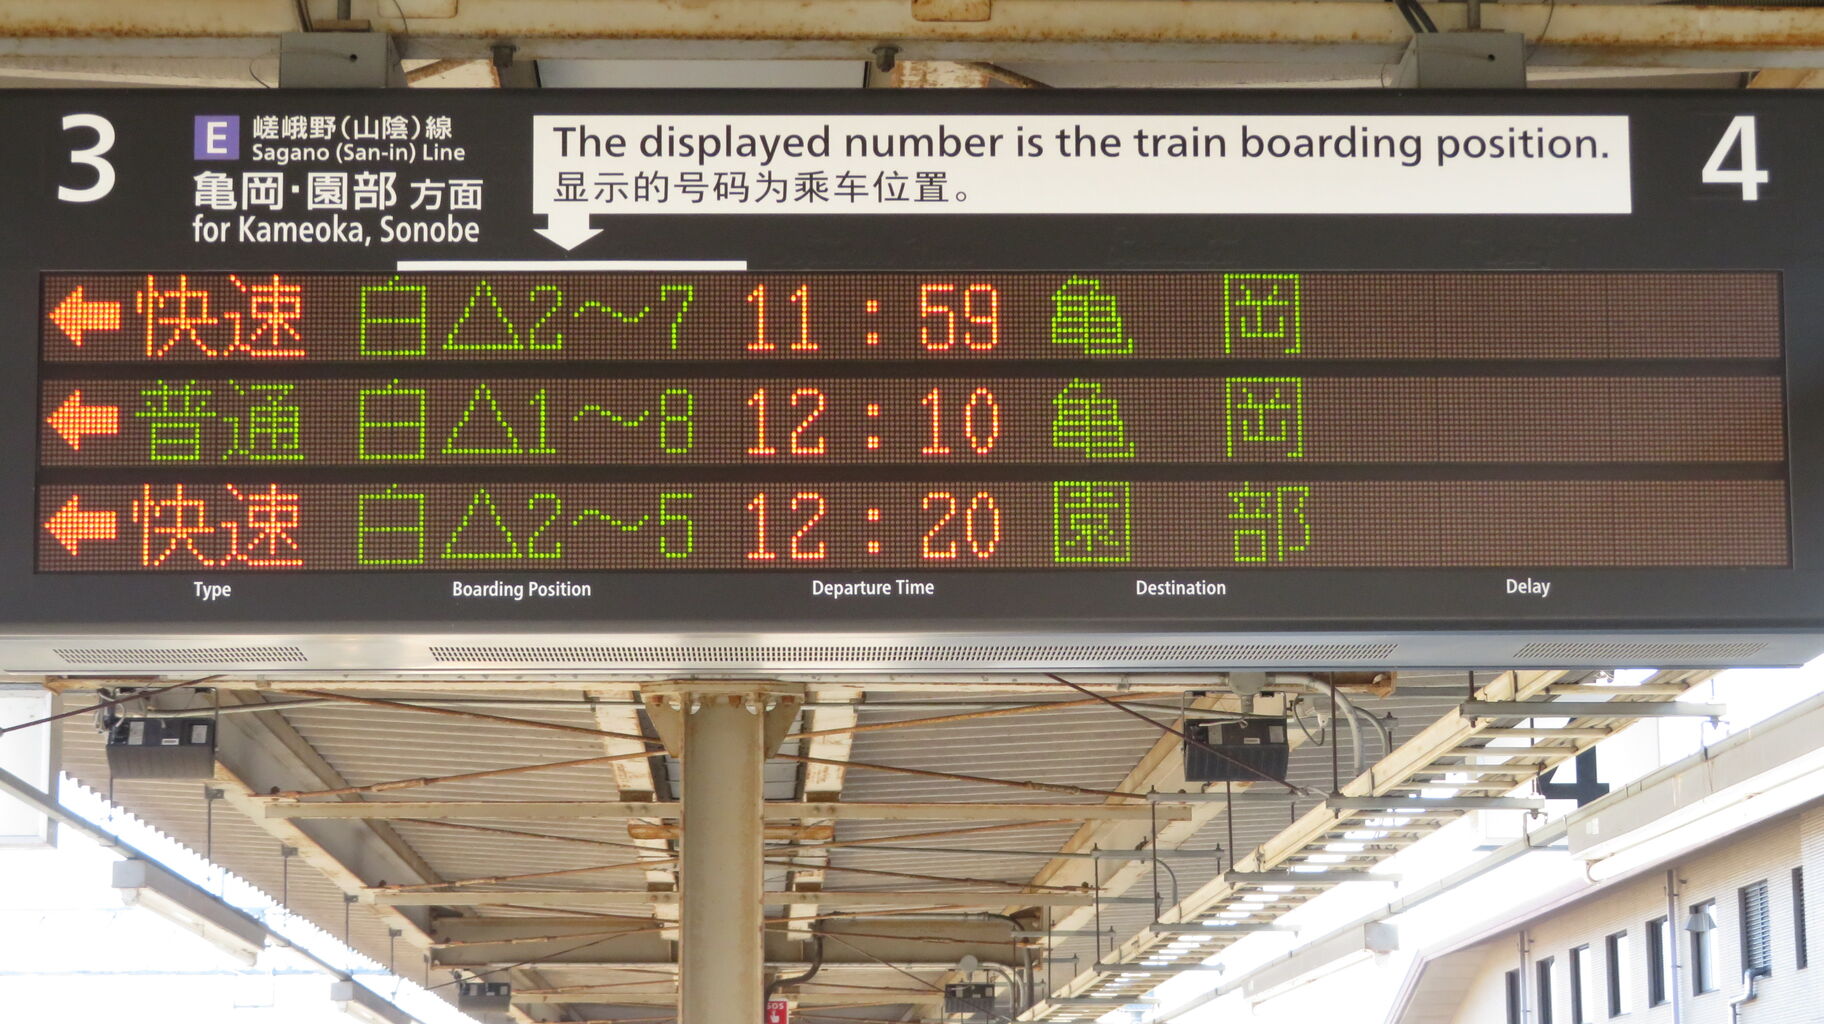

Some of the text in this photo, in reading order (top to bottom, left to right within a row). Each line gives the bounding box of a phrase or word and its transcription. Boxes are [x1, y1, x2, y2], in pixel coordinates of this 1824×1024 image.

[206, 121, 227, 154] E
[553, 125, 1607, 166] The displayed number is the train boarding position.
[58, 114, 115, 202] 3
[253, 143, 465, 165] Sagano (San-in) Line
[1702, 116, 1768, 200] 4
[554, 171, 966, 203] 显示的号码为乘车位置。
[193, 214, 479, 246] for Kameoka, Sonobe
[137, 275, 305, 357] 快速
[136, 380, 304, 460] 普通
[133, 484, 302, 566] 快速
[194, 582, 231, 600] Type
[453, 581, 591, 600] Boarding Position
[813, 580, 934, 599] Departure Time
[1137, 580, 1226, 595] Destination
[1507, 578, 1550, 597] Delay
